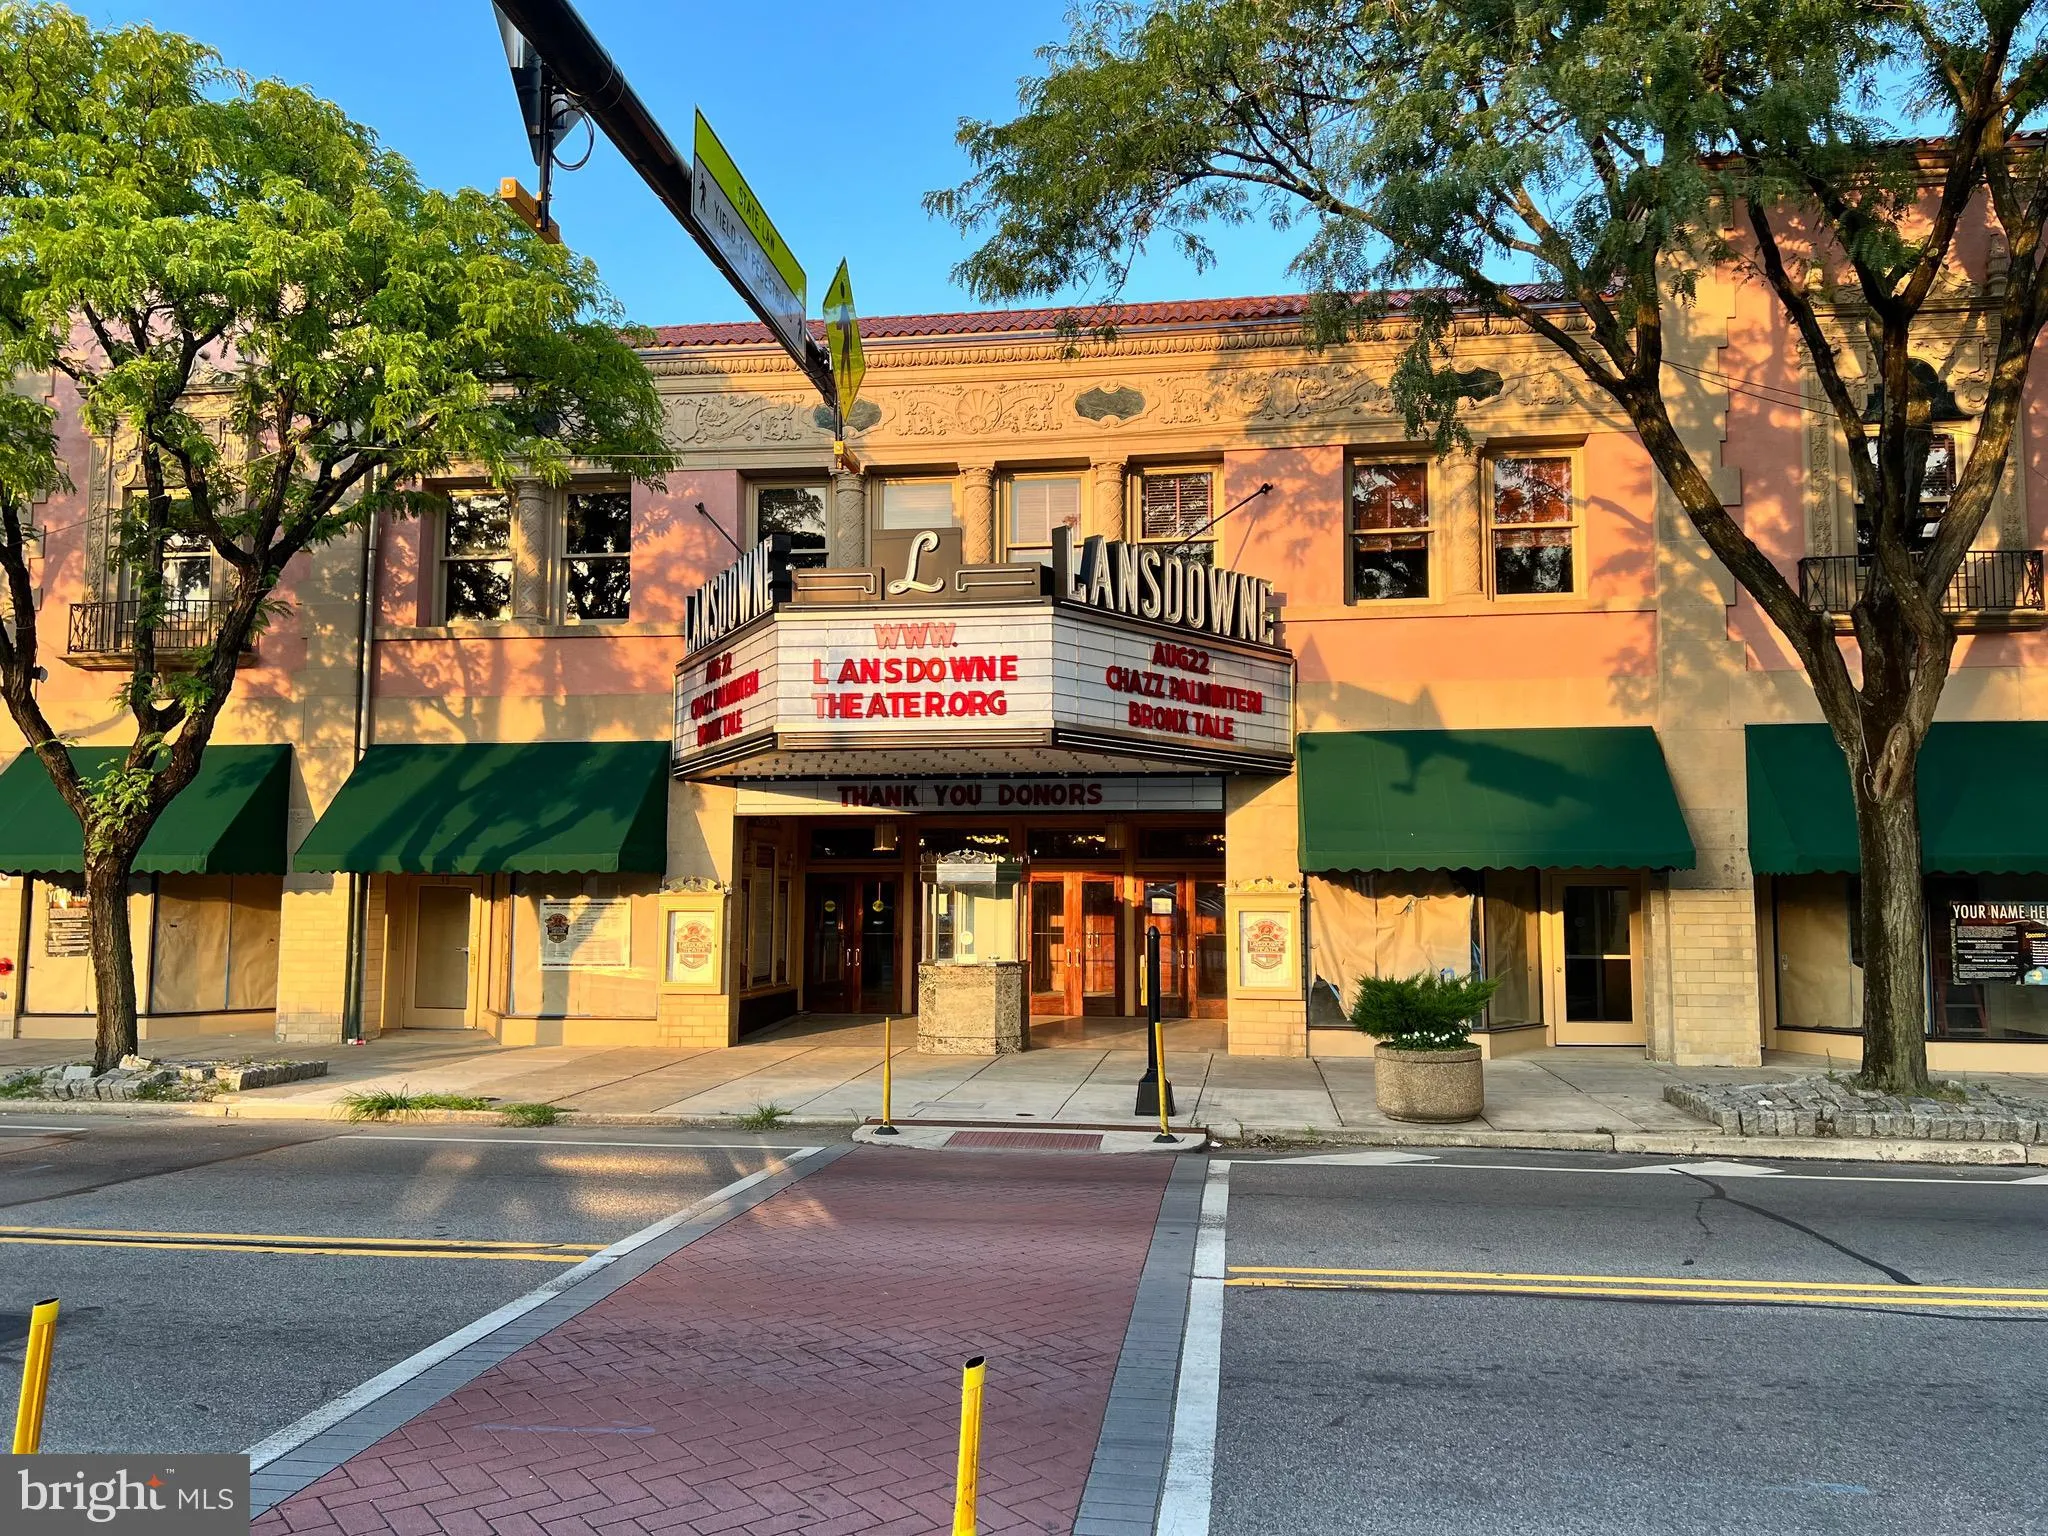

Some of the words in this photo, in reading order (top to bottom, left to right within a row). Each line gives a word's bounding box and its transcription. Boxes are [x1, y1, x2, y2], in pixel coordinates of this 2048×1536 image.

[714, 200, 736, 244] YIELD
[739, 236, 749, 261] TO
[738, 186, 759, 230] STATE
[762, 223, 776, 252] LAW
[886, 530, 945, 596] L
[1060, 526, 1275, 646] LANSDOWNE
[685, 534, 774, 654] LANSDOWNE
[1105, 665, 1166, 699] CHAZZ
[1169, 676, 1263, 714] PALMINTERI
[1128, 701, 1190, 736] BRONX
[1192, 711, 1235, 741] TALE
[837, 785, 919, 807] THANK
[933, 784, 983, 806] YOU
[998, 783, 1104, 806] DONORS
[1952, 904, 1987, 919] YOUR
[1990, 904, 2026, 919] NAME
[2030, 904, 2048, 919] HE
